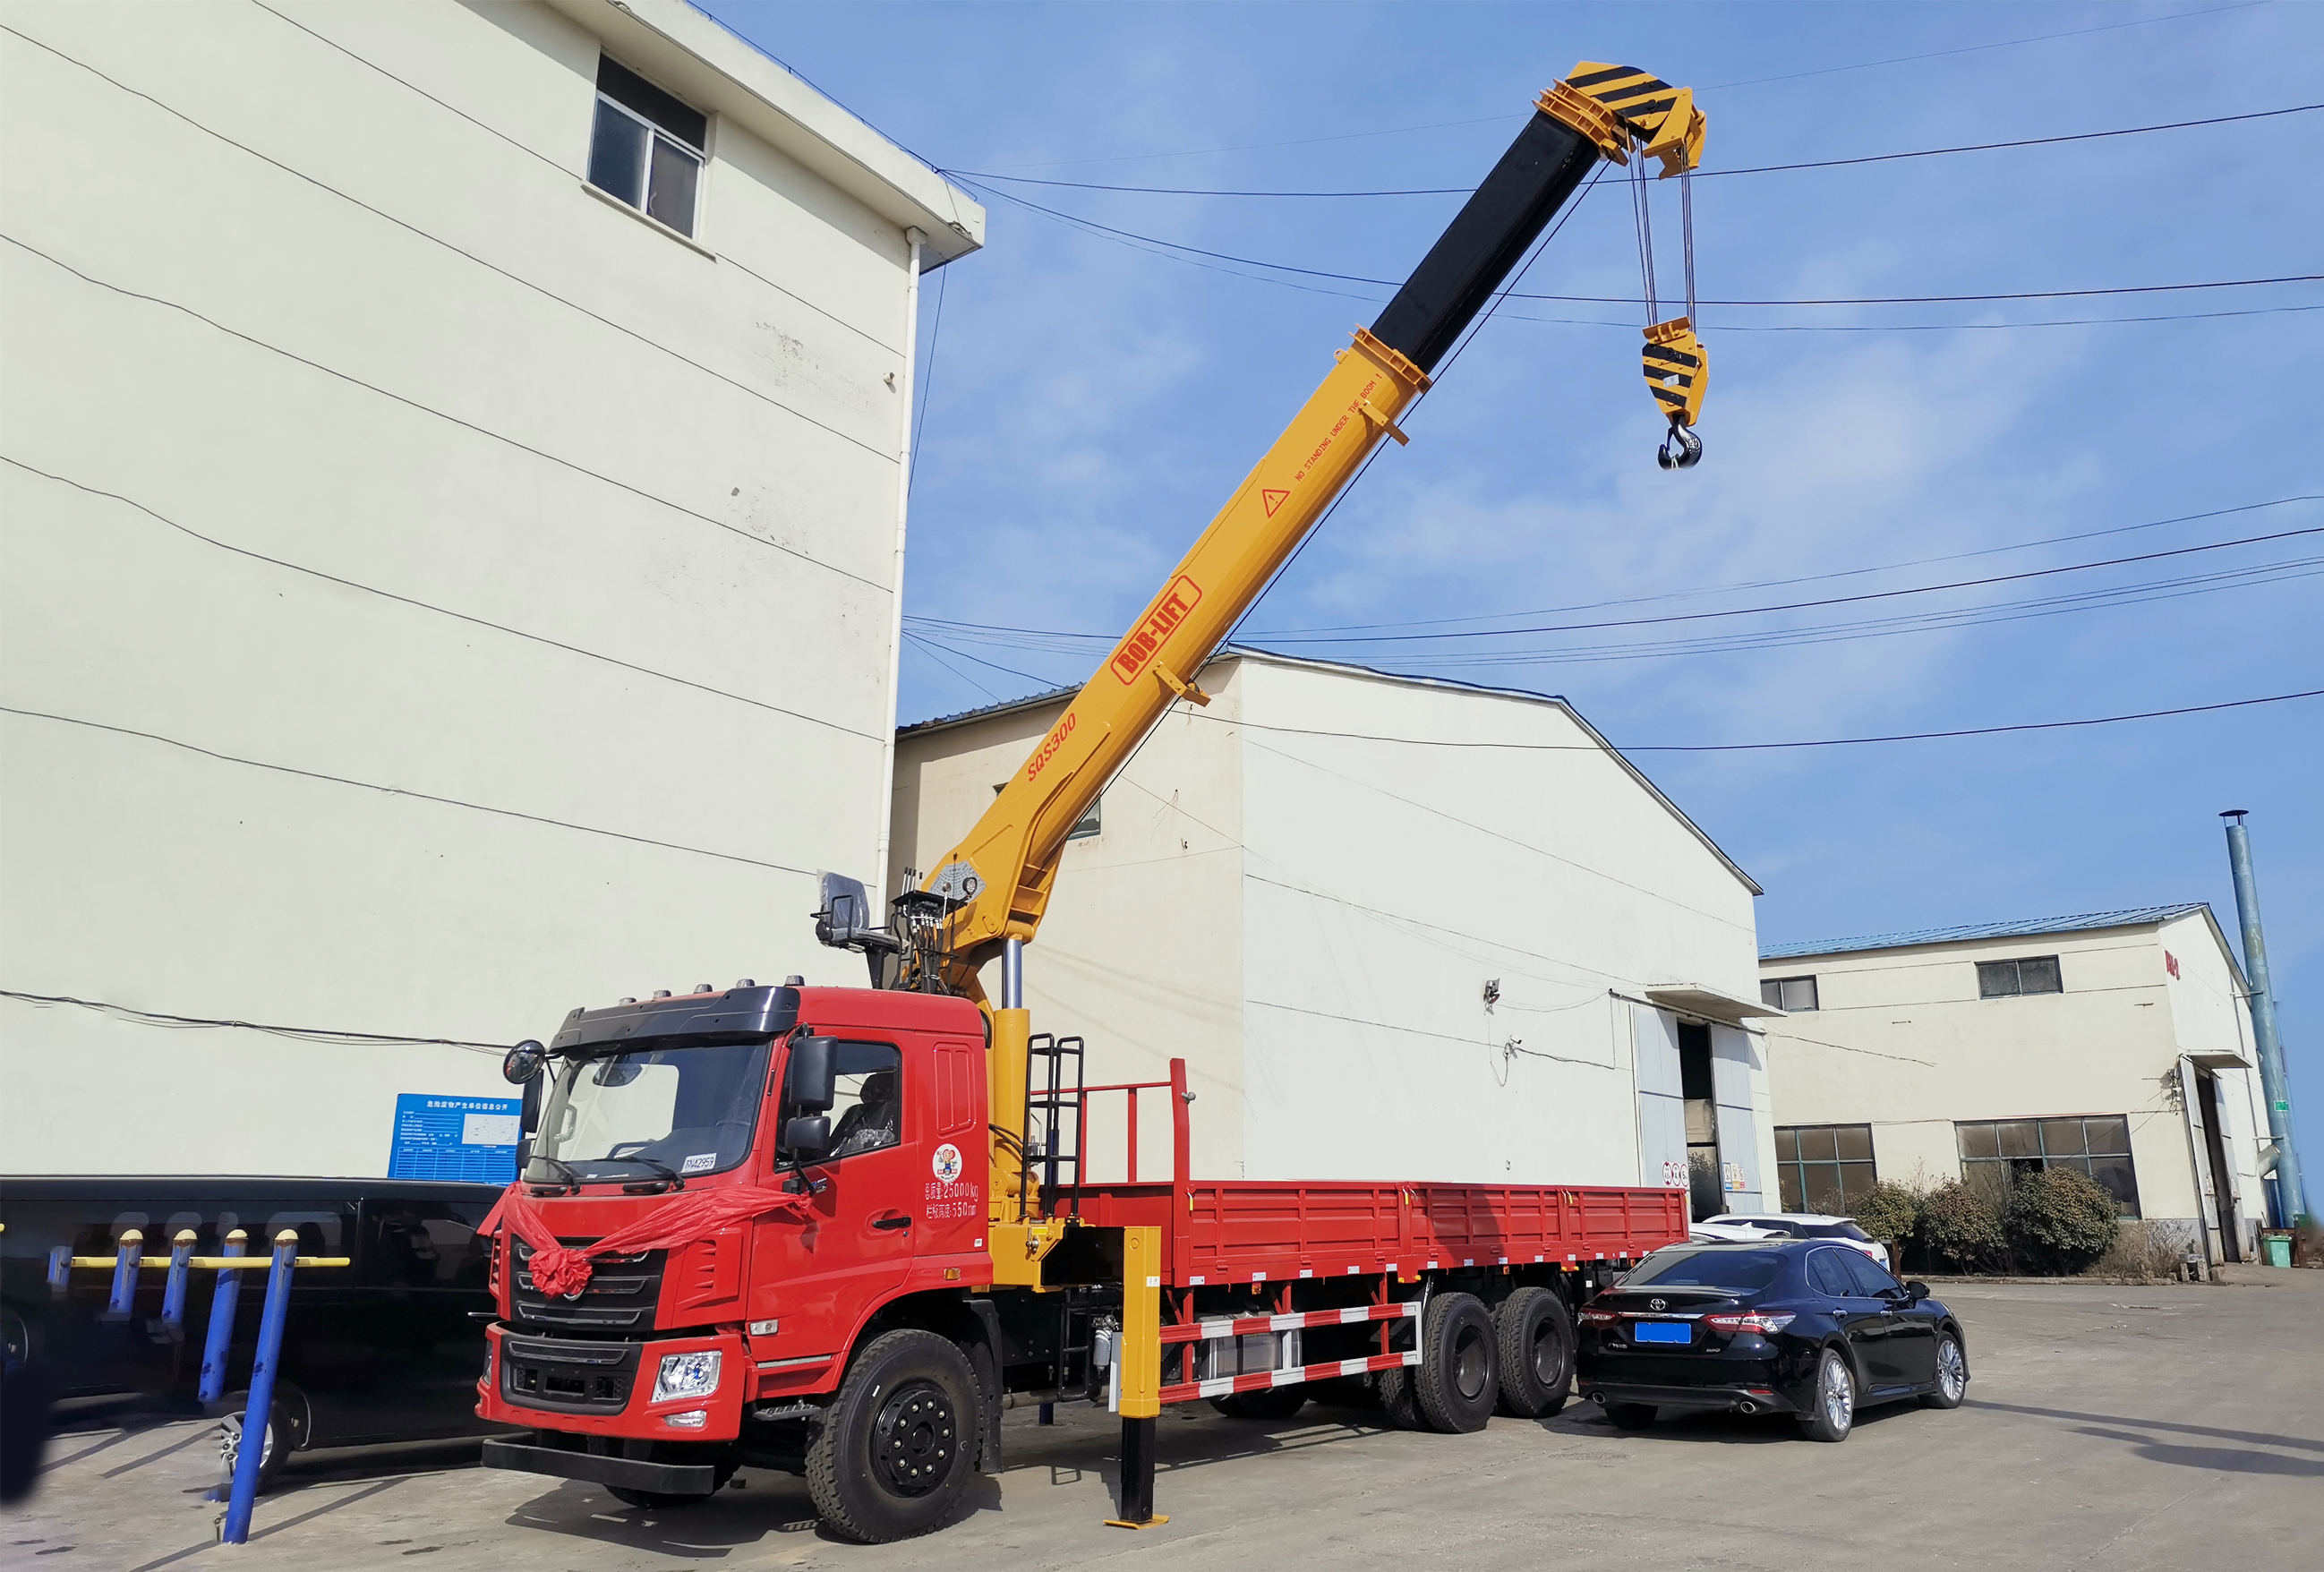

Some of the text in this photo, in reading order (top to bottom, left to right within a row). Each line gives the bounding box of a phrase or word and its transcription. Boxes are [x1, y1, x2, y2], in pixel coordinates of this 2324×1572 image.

[1294, 471, 1305, 482] NO
[1304, 437, 1332, 470] STANDING
[1329, 414, 1350, 437] UNDER
[1347, 399, 1361, 414] THE
[1360, 380, 1377, 399] BOOM
[1116, 592, 1189, 675] BOB-LIFT
[1028, 712, 1076, 782] SQS300
[426, 1099, 508, 1111] 危险废物产生单位信息公开
